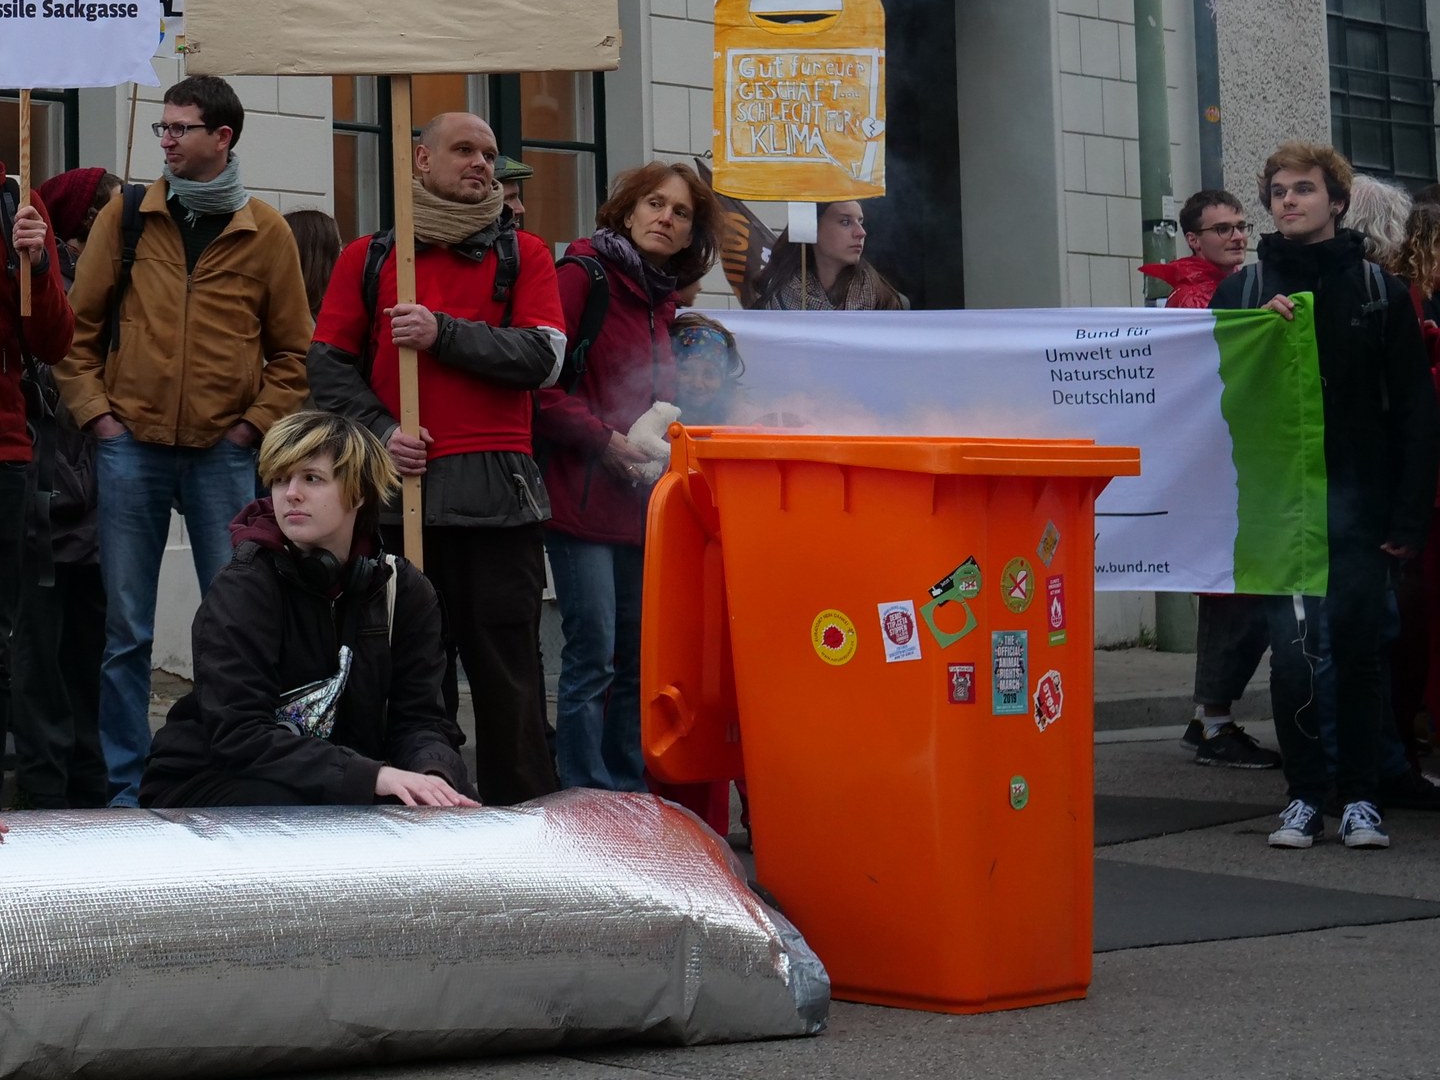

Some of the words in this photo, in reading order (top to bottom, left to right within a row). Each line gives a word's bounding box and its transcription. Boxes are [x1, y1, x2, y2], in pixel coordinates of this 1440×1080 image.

[43, 0, 139, 22] Sackgasse
[737, 56, 785, 78] Gut
[735, 101, 825, 125] SCHLECHT
[750, 122, 830, 156] KLIMA
[1075, 328, 1119, 340] Bund
[1126, 326, 1152, 338] für
[1045, 347, 1112, 363] Umwelt
[1119, 344, 1153, 360] und
[1050, 365, 1156, 382] Naturschutz
[1052, 388, 1157, 405] Deutschland
